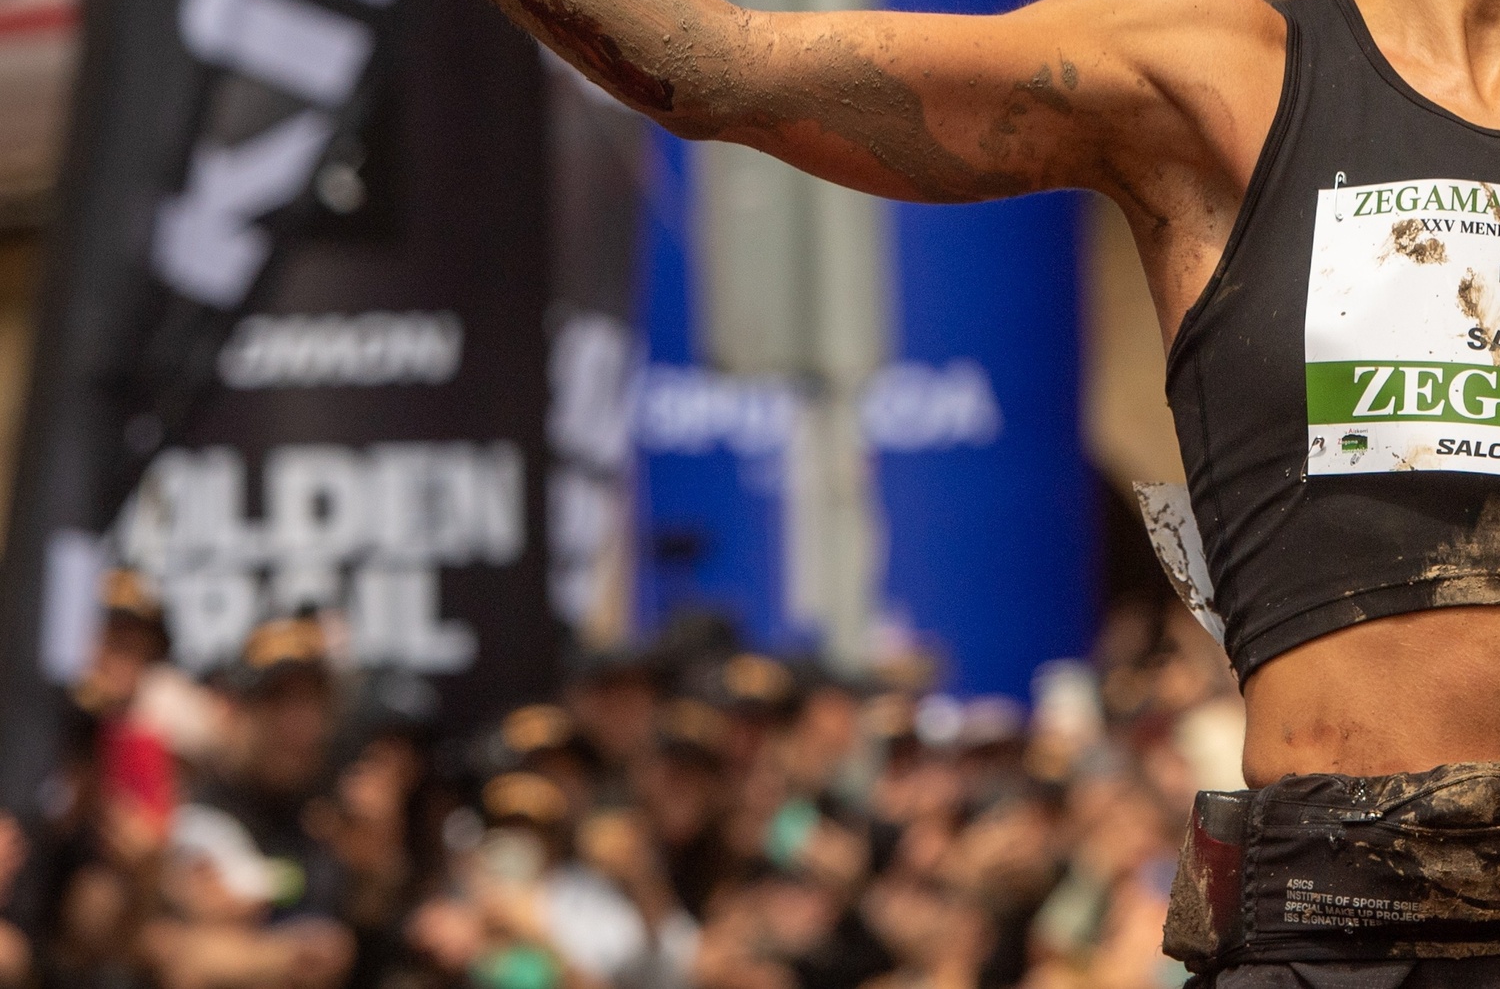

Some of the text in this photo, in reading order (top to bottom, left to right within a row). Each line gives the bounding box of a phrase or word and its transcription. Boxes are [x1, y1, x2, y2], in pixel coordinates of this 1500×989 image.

[1420, 218, 1456, 232] XXV
[1286, 879, 1314, 890] ASICS
[1335, 895, 1350, 906] OF
[1352, 897, 1390, 910] SPORT
[1283, 912, 1300, 923] ISS
[1325, 905, 1355, 917] MAKE
[1358, 909, 1374, 919] UP
